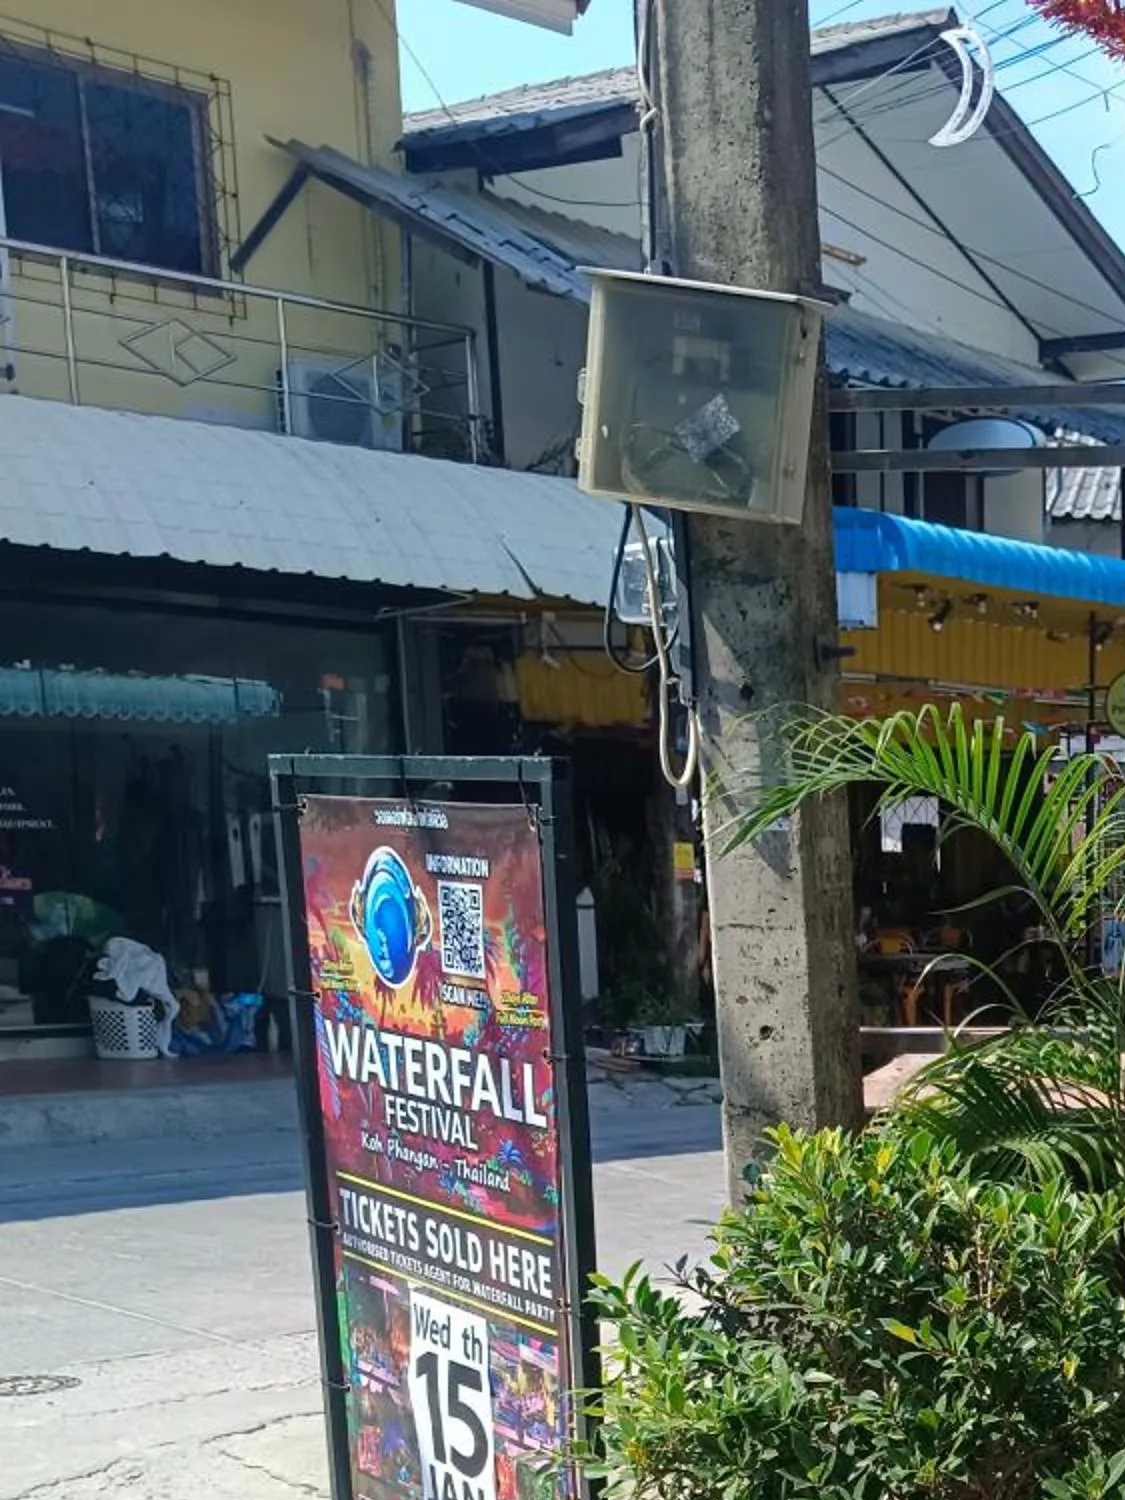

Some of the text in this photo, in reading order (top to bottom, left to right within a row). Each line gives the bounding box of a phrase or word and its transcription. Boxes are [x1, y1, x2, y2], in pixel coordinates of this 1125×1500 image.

[425, 853, 489, 878] INFORMATION
[324, 1019, 548, 1129] WATERFALL
[384, 1093, 479, 1150] FESTIVAL
[361, 1131, 383, 1154] Koh
[387, 1138, 438, 1172] Phangan
[455, 1159, 511, 1192] Thailand
[339, 1188, 554, 1299] TICKETS SOLD HERE
[424, 1265, 451, 1284] AGENT
[453, 1273, 471, 1293] FOR
[473, 1282, 524, 1313] WATERFALL
[413, 1303, 483, 1365] Wed th
[415, 1351, 489, 1478] 15
